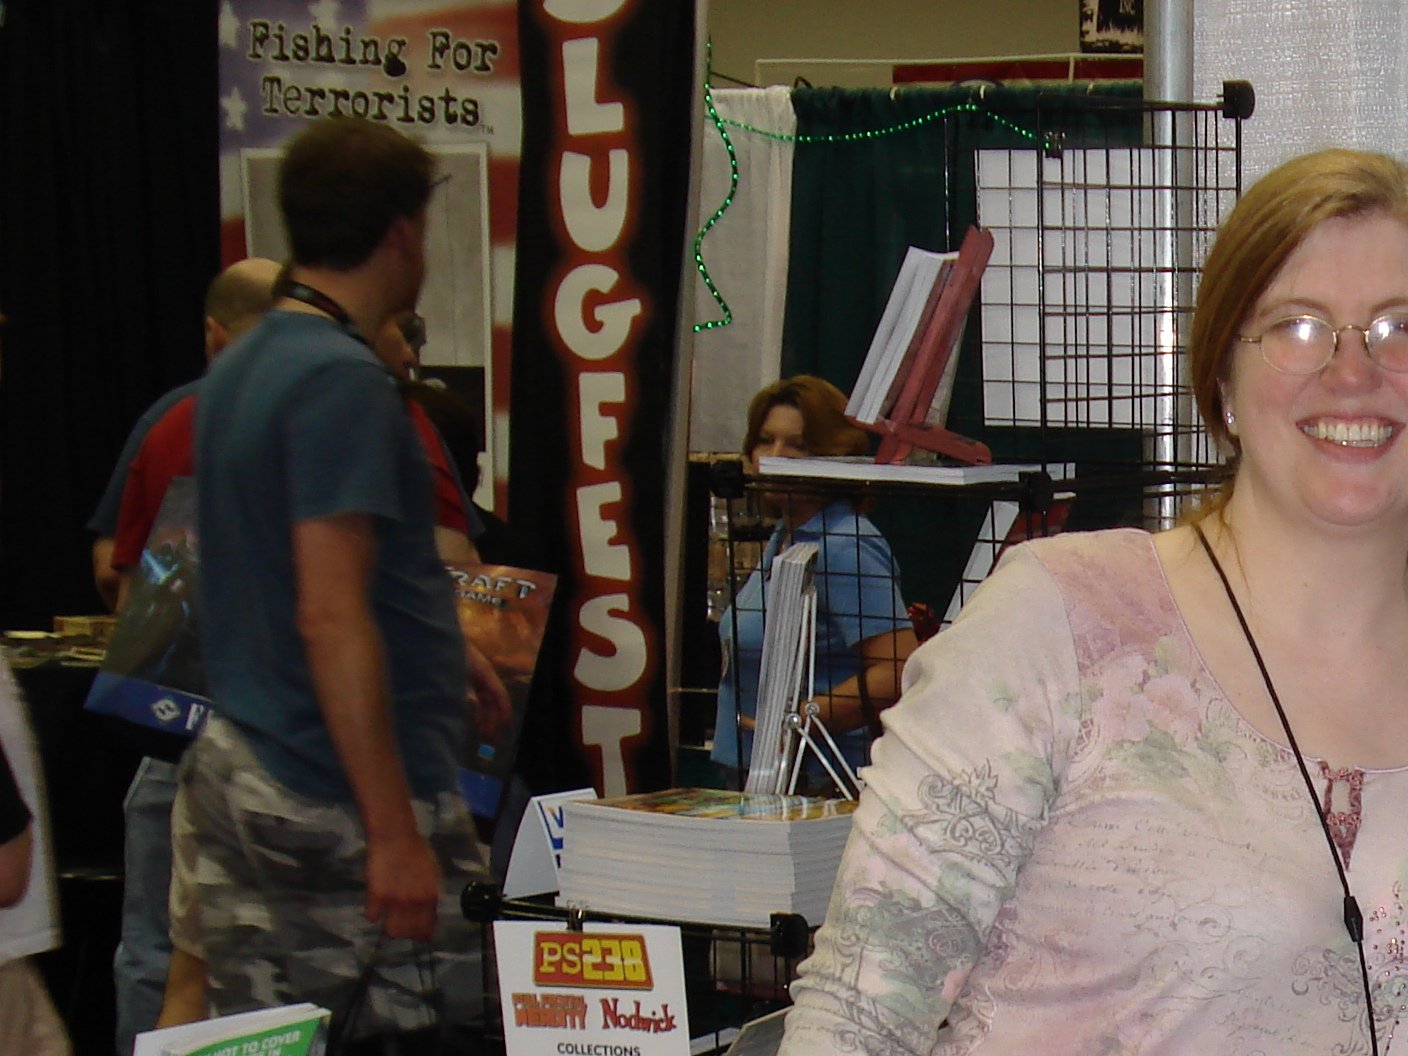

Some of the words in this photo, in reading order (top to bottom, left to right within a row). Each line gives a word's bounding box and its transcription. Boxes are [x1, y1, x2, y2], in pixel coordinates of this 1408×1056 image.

[249, 20, 407, 77] Fishing
[427, 30, 498, 72] For
[262, 76, 480, 127] Terrorists
[543, 0, 647, 797] LUGFEST
[539, 938, 647, 982] PS238
[599, 997, 677, 1034] Nodwick
